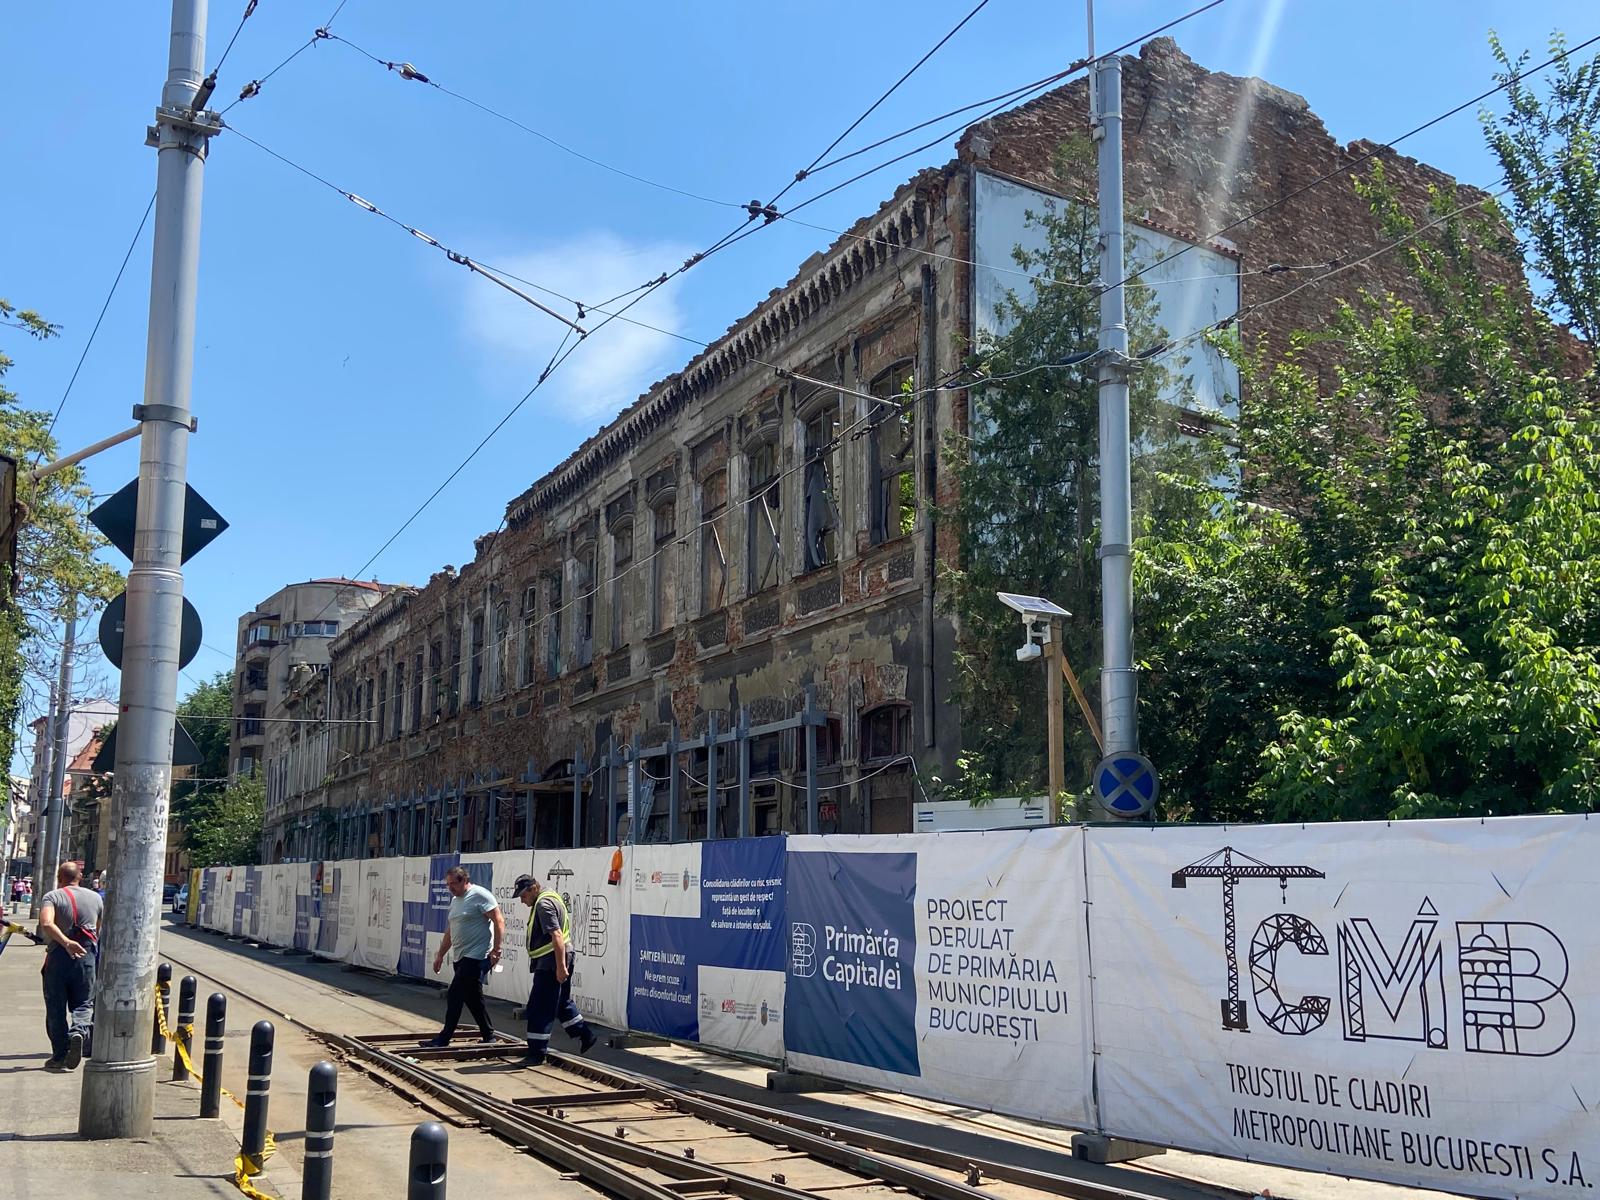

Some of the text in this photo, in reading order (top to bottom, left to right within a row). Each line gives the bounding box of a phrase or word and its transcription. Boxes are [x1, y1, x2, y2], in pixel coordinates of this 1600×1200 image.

[927, 898, 1007, 921] PROIECT
[825, 925, 899, 957] Primăria
[928, 926, 1014, 950] DERULAT
[823, 955, 901, 991] Capitalei
[928, 952, 1057, 983] DE PRIMĂRIA
[928, 980, 1068, 1014] MUNICIPIULUI
[929, 1007, 1039, 1046] BUCUREȘTI
[1226, 1063, 1431, 1118] TRUSTUL DE CLADIRI
[1232, 1108, 1593, 1188] METROPOLITANE BUCURESTI S.A.
